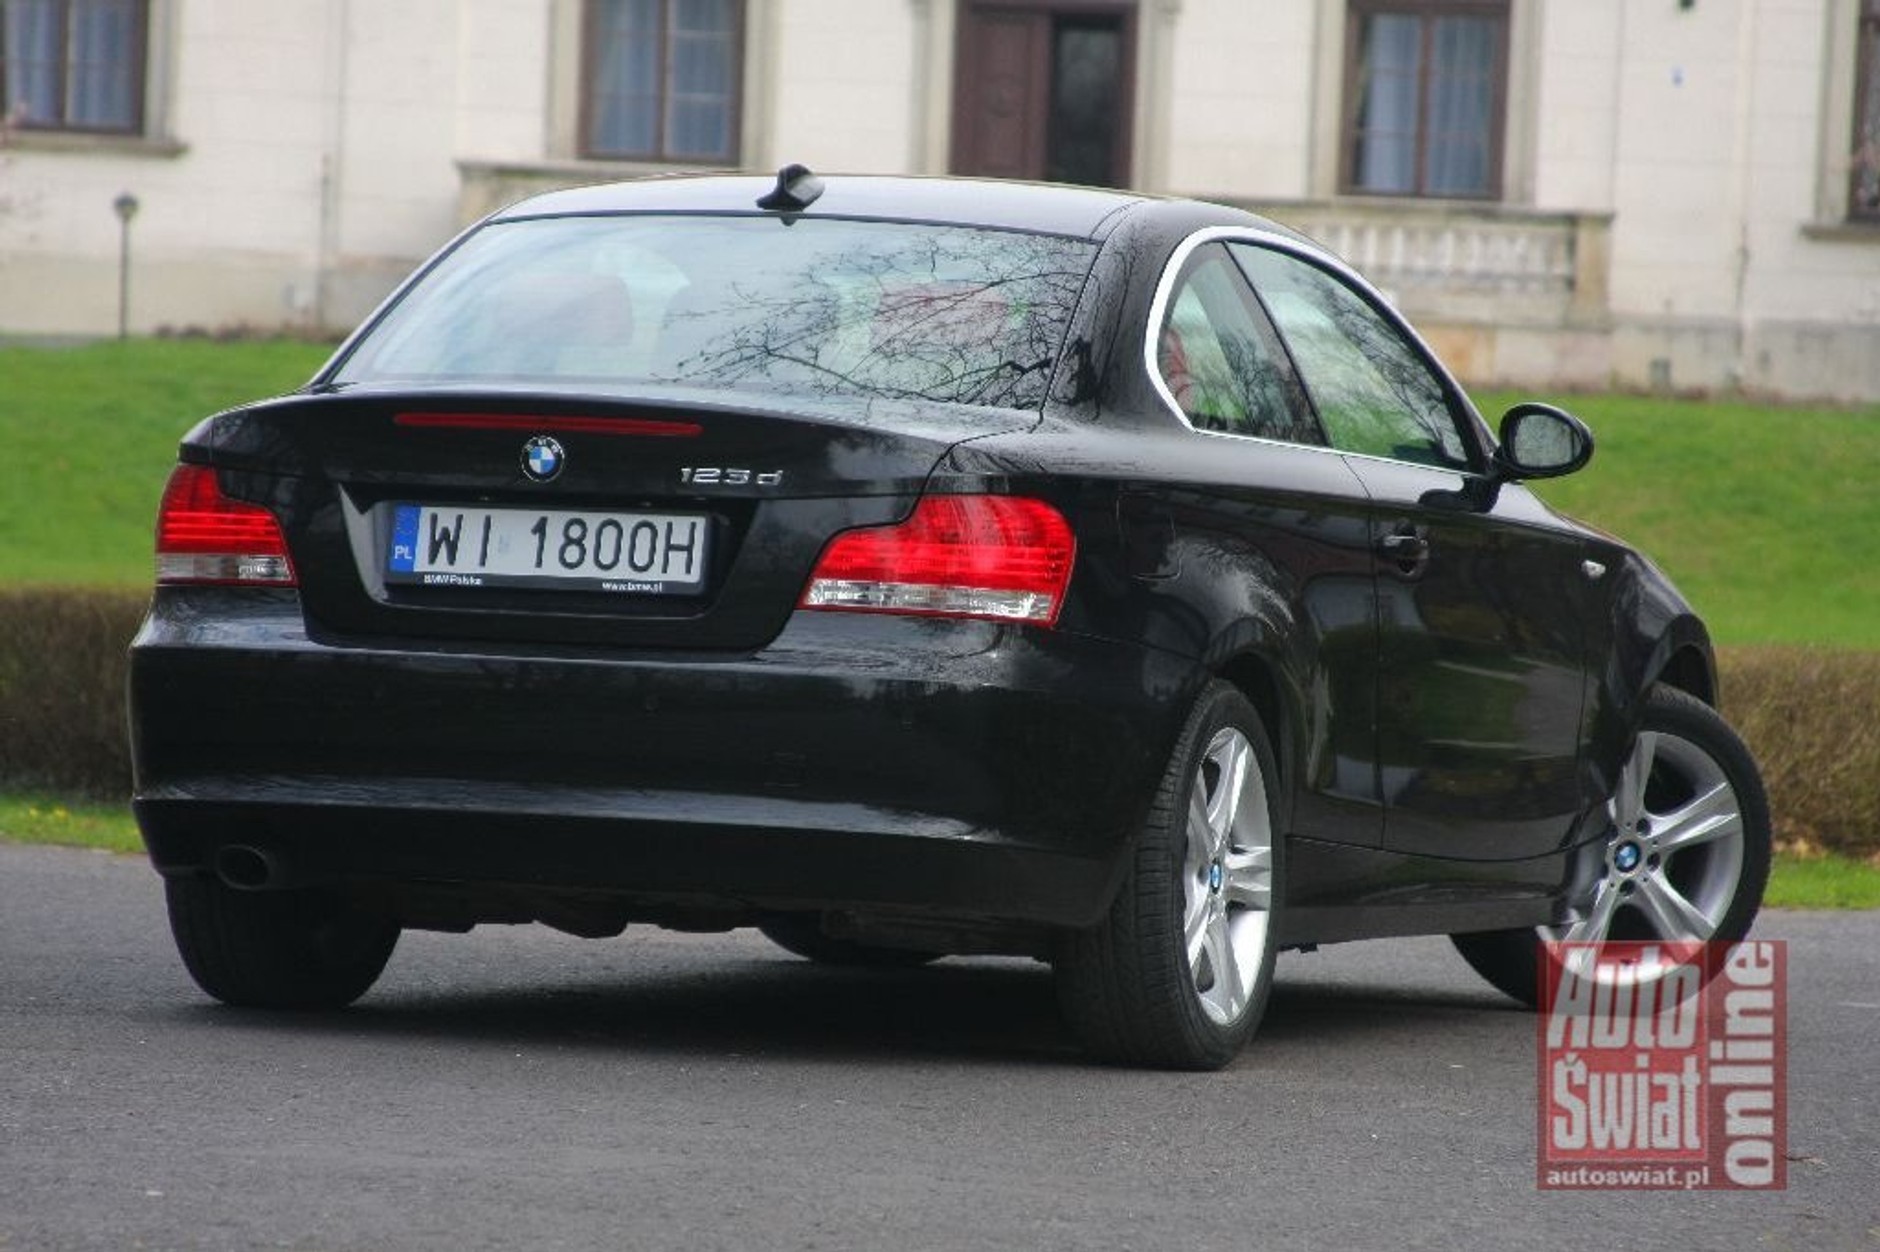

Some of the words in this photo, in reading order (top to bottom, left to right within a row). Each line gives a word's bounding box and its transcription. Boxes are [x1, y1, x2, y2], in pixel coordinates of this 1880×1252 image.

[394, 545, 413, 560] PL
[428, 512, 492, 567] WI
[530, 516, 698, 575] 1800H
